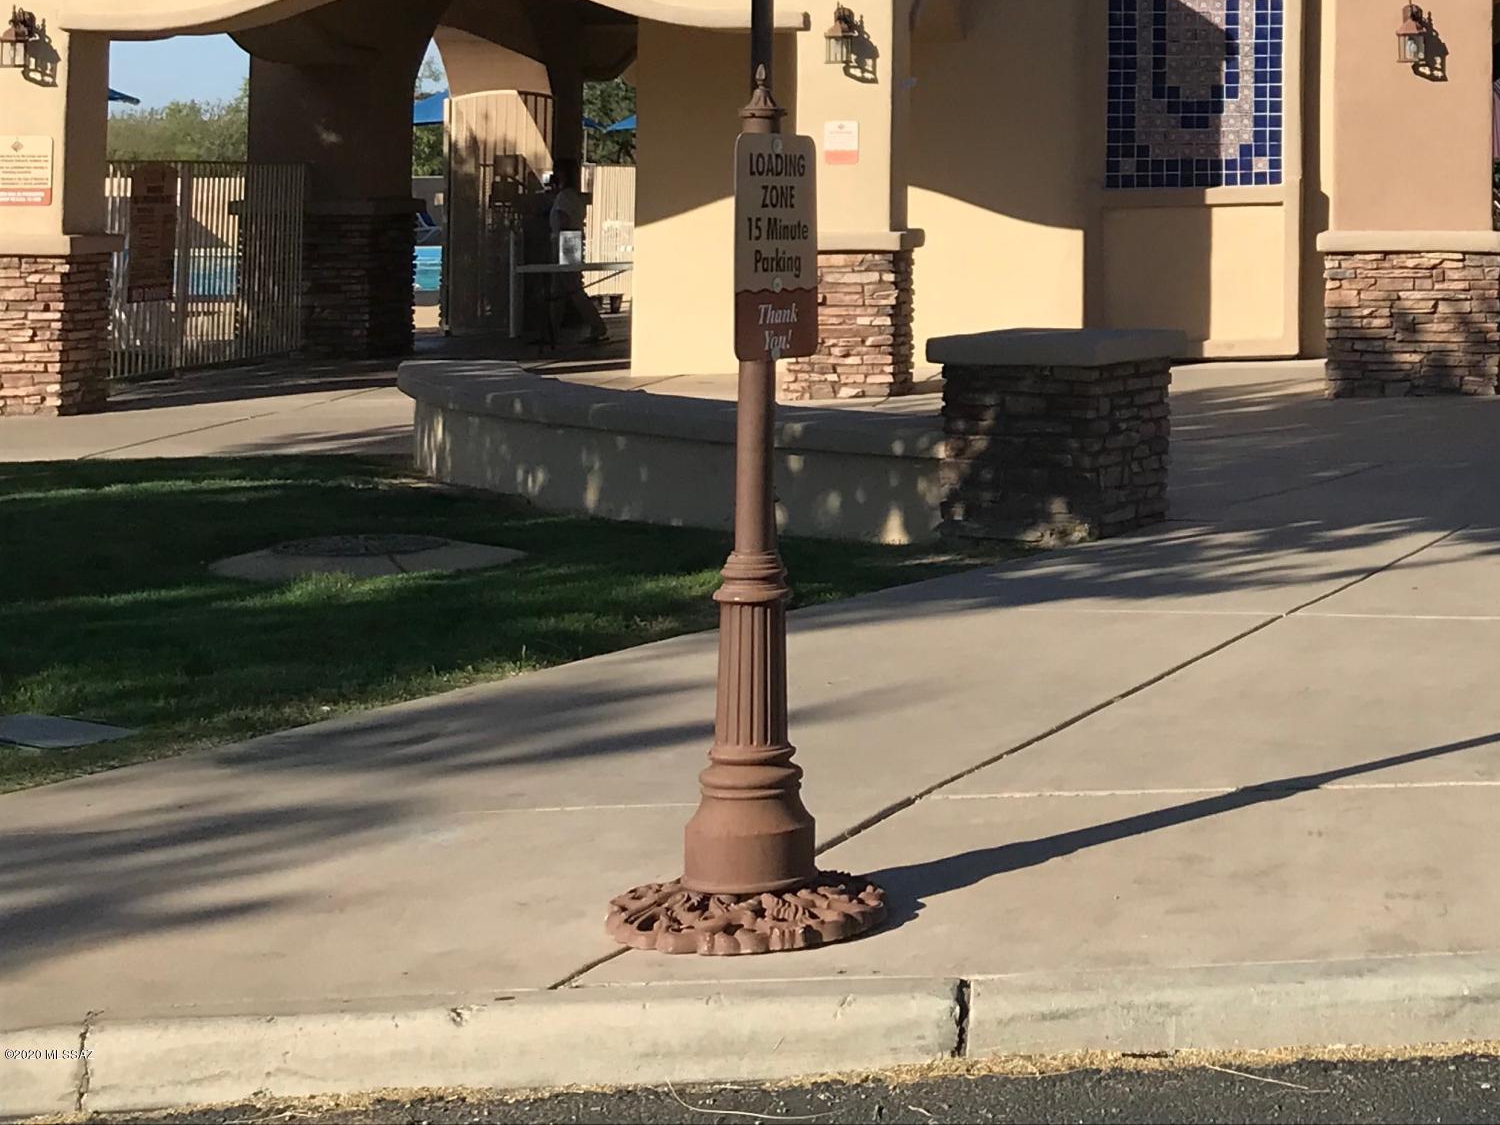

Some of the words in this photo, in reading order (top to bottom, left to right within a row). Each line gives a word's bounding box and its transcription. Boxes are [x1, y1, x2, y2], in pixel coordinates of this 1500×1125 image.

[749, 152, 806, 177] LOADING
[761, 185, 795, 209] ZONE
[747, 216, 762, 241] 15
[766, 216, 809, 241] Minute
[754, 247, 801, 278] Parking
[758, 302, 798, 325] Thank
[764, 329, 792, 350] You!
